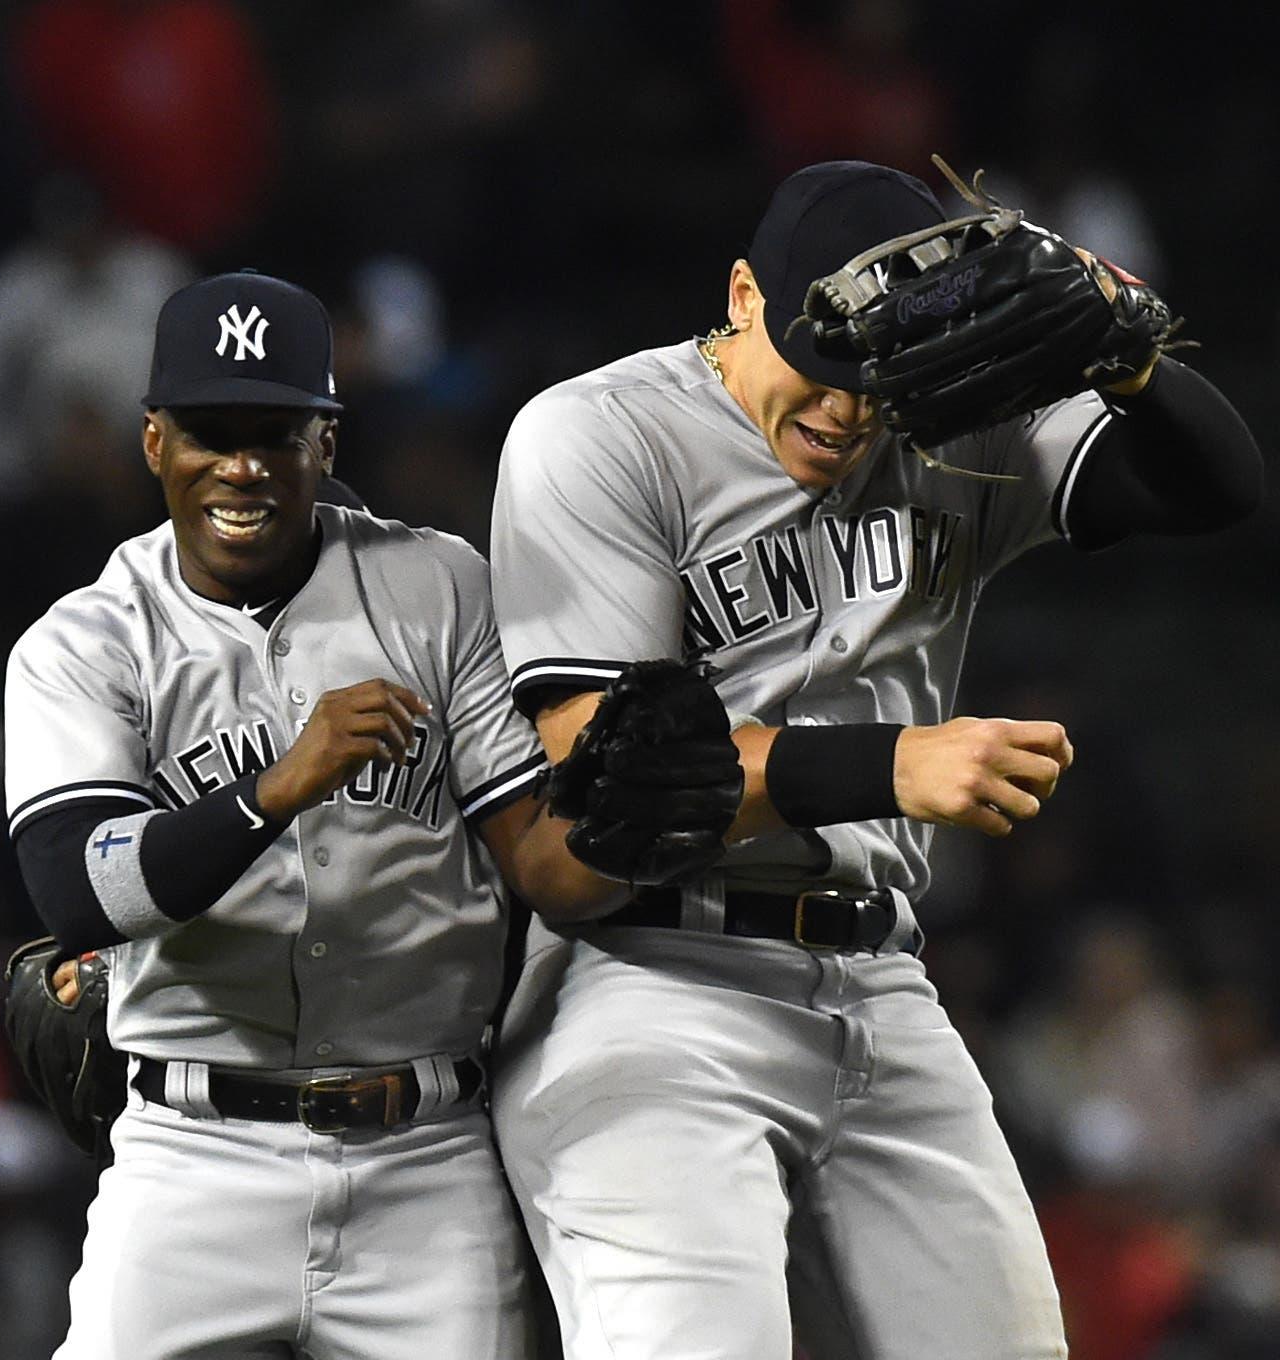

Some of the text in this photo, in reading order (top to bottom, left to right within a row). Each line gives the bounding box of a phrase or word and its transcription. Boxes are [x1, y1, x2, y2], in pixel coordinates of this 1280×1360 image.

[214, 303, 271, 361] NY
[680, 523, 819, 651] NEW
[295, 717, 451, 831] RK
